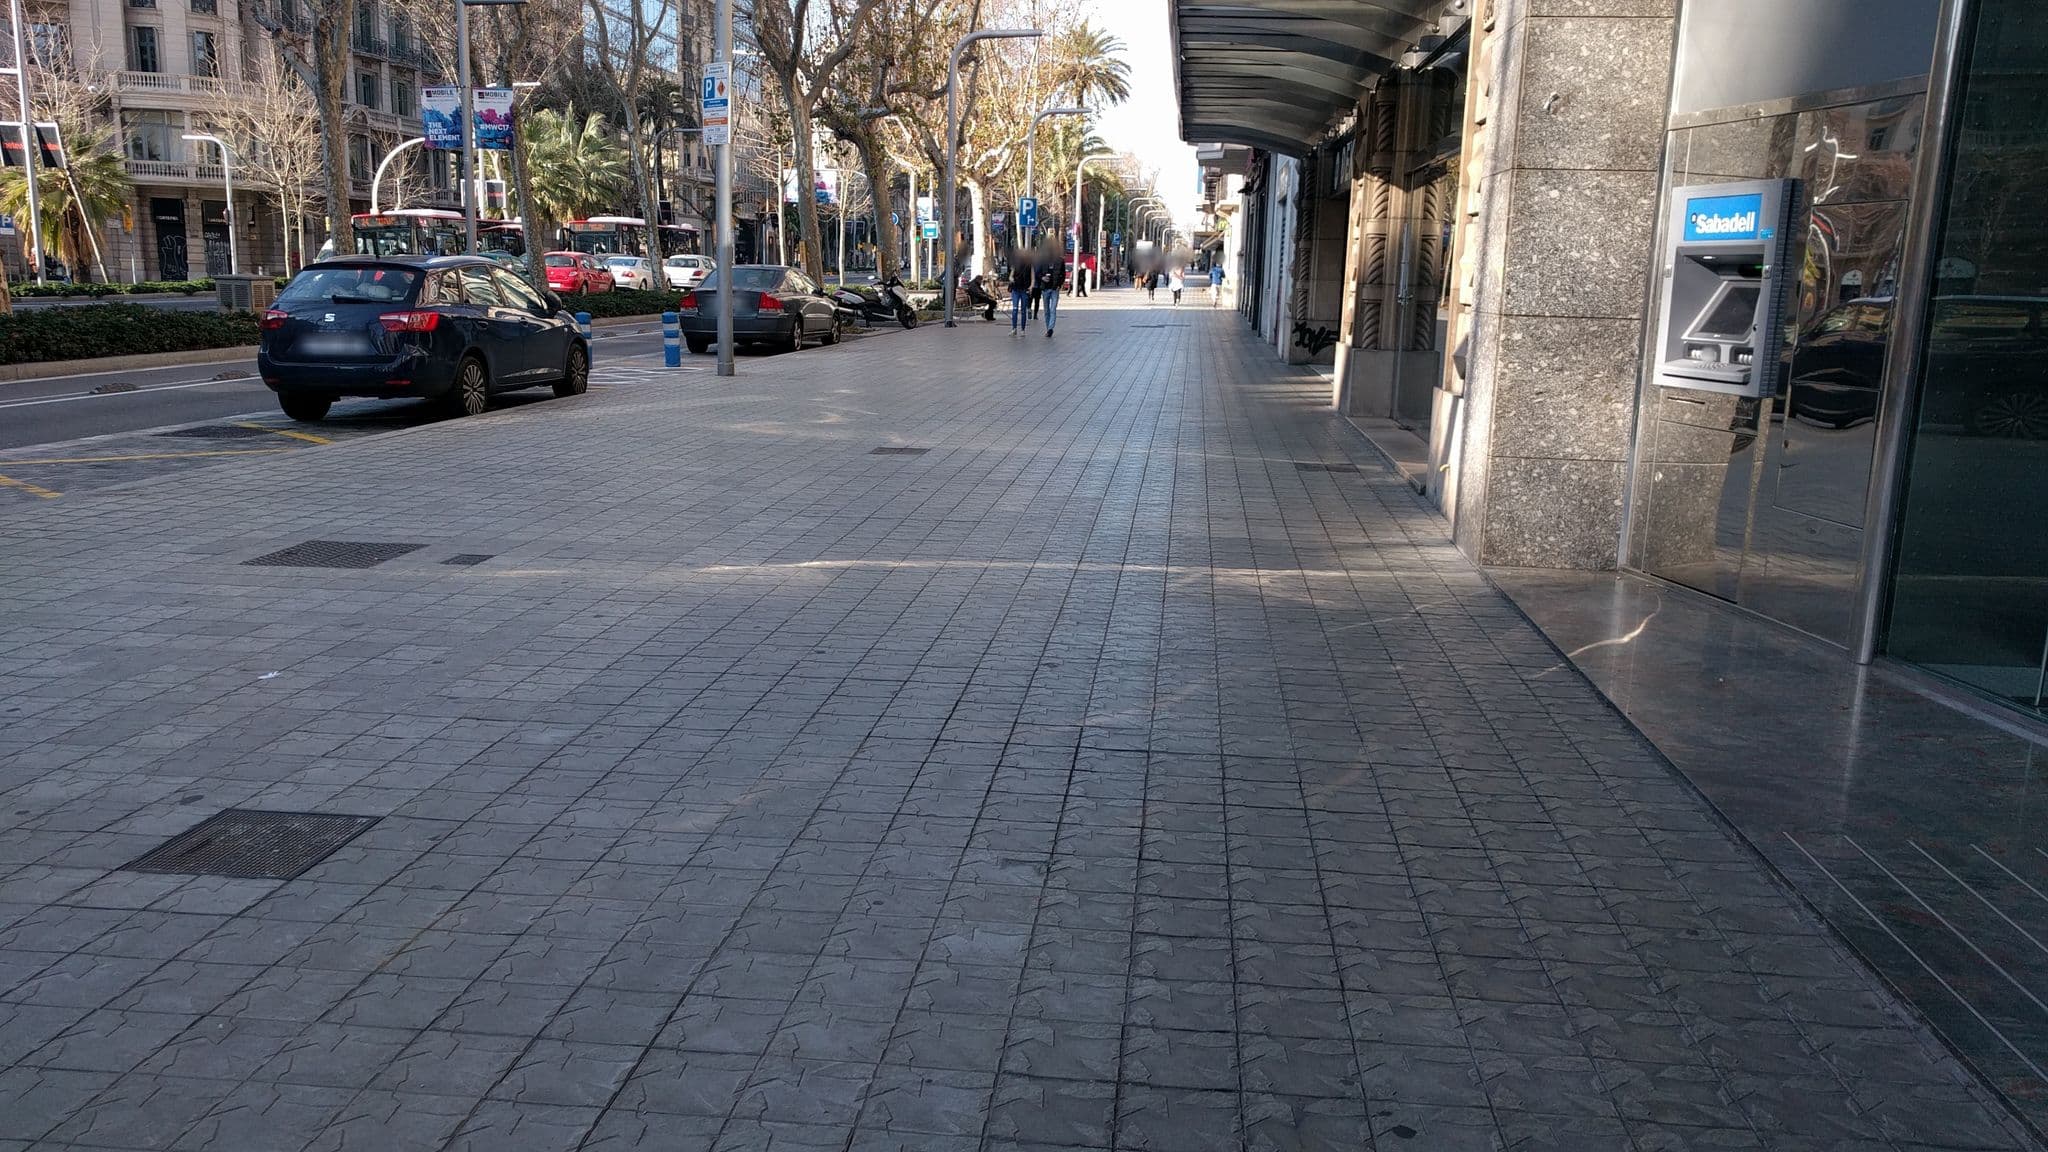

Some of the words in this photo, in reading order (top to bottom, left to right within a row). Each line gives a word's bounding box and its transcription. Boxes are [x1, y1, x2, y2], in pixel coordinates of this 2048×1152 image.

[705, 79, 713, 98] P
[1022, 200, 1034, 215] P
[2, 215, 12, 228] P
[1695, 211, 1756, 234] Sabadell
